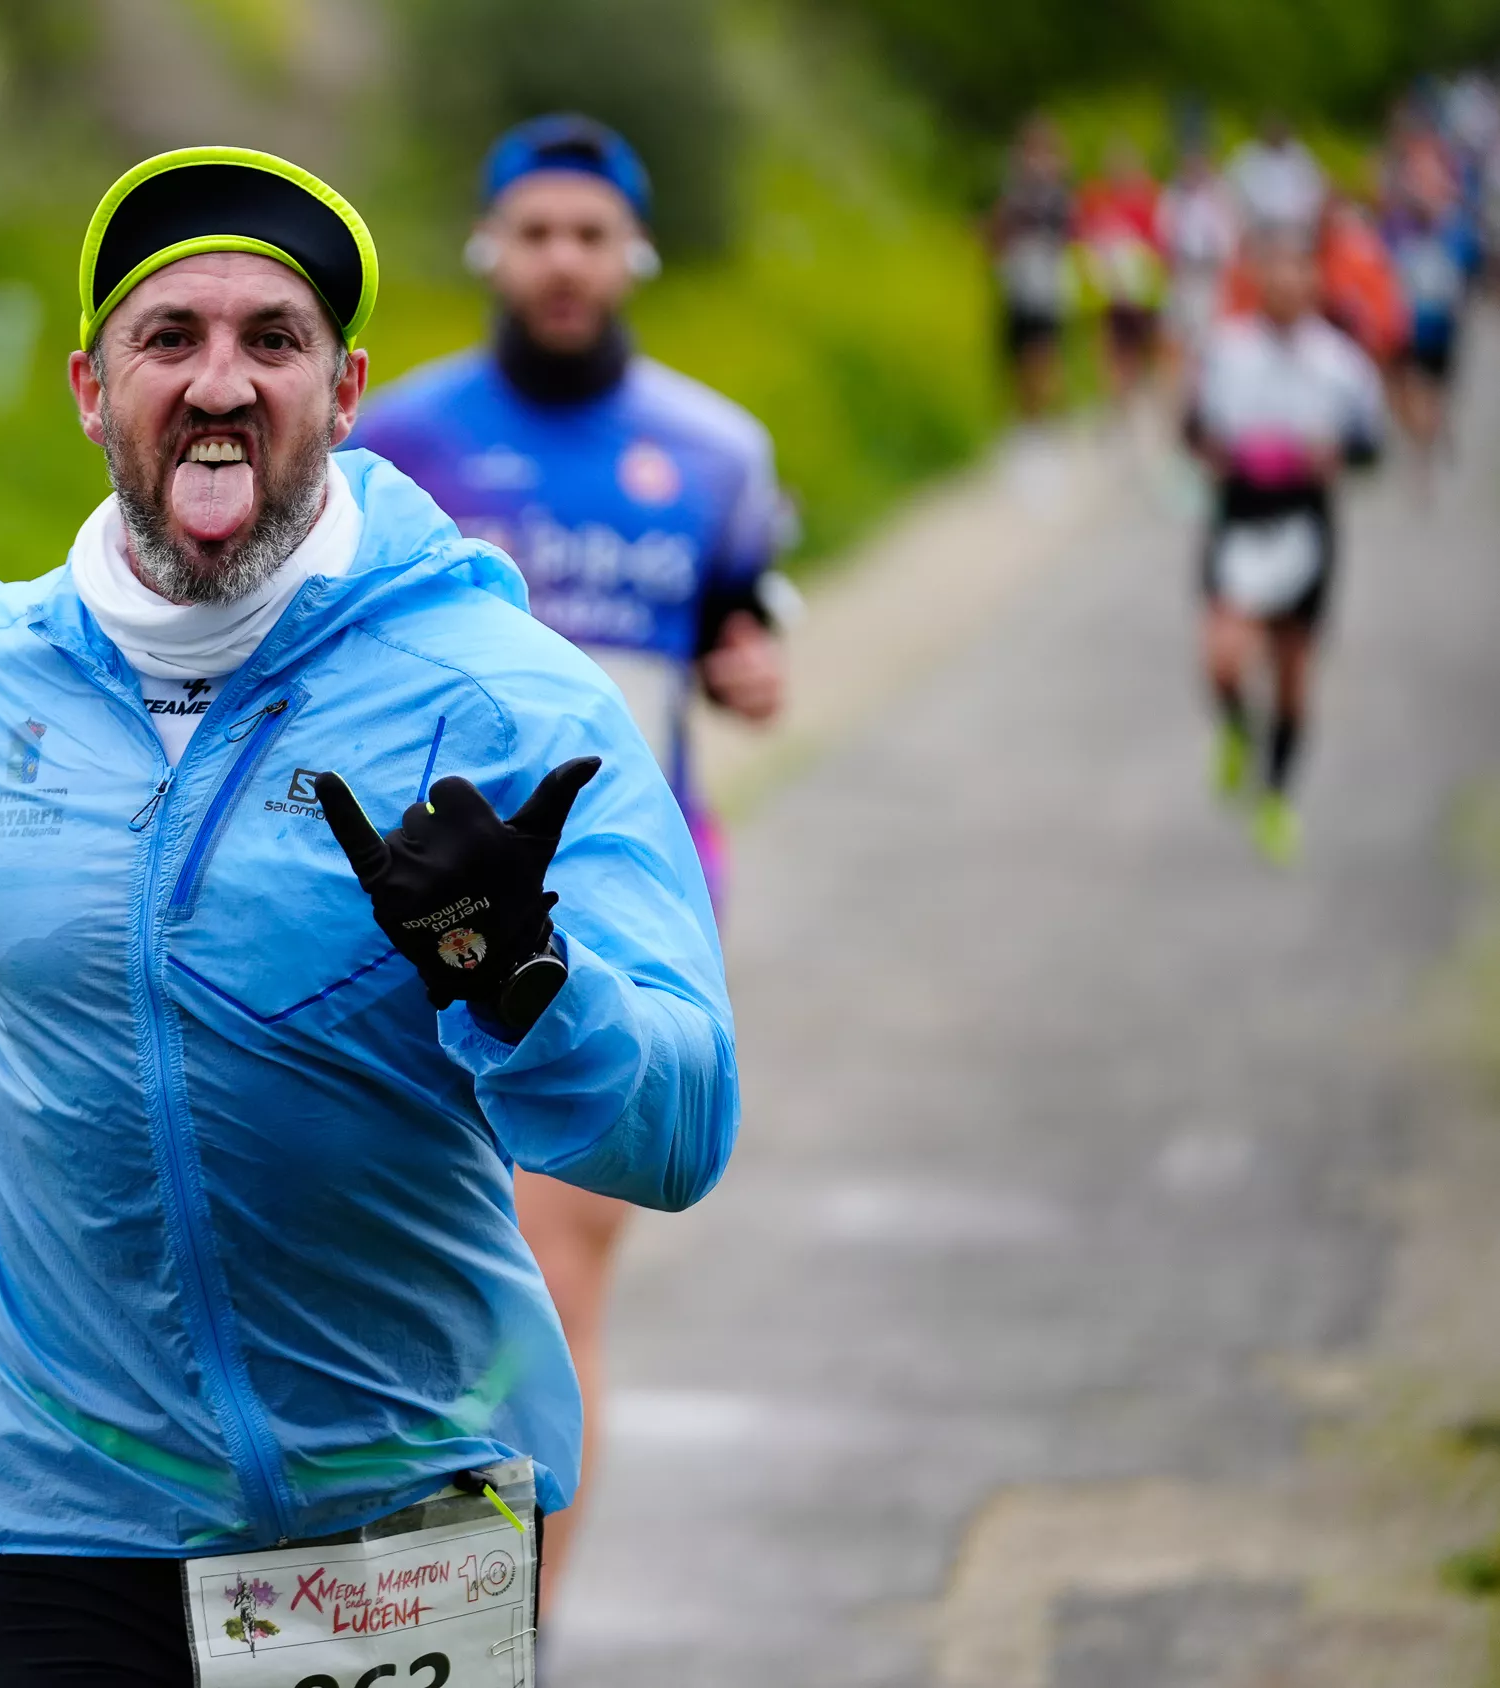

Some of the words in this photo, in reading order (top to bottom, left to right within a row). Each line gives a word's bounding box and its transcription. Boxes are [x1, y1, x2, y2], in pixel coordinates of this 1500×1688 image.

[402, 896, 471, 929] armadas
[432, 896, 490, 933] fuerzas
[290, 1567, 326, 1615] X
[377, 1560, 450, 1595] MARATÓN
[333, 1596, 438, 1634] LUCENA
